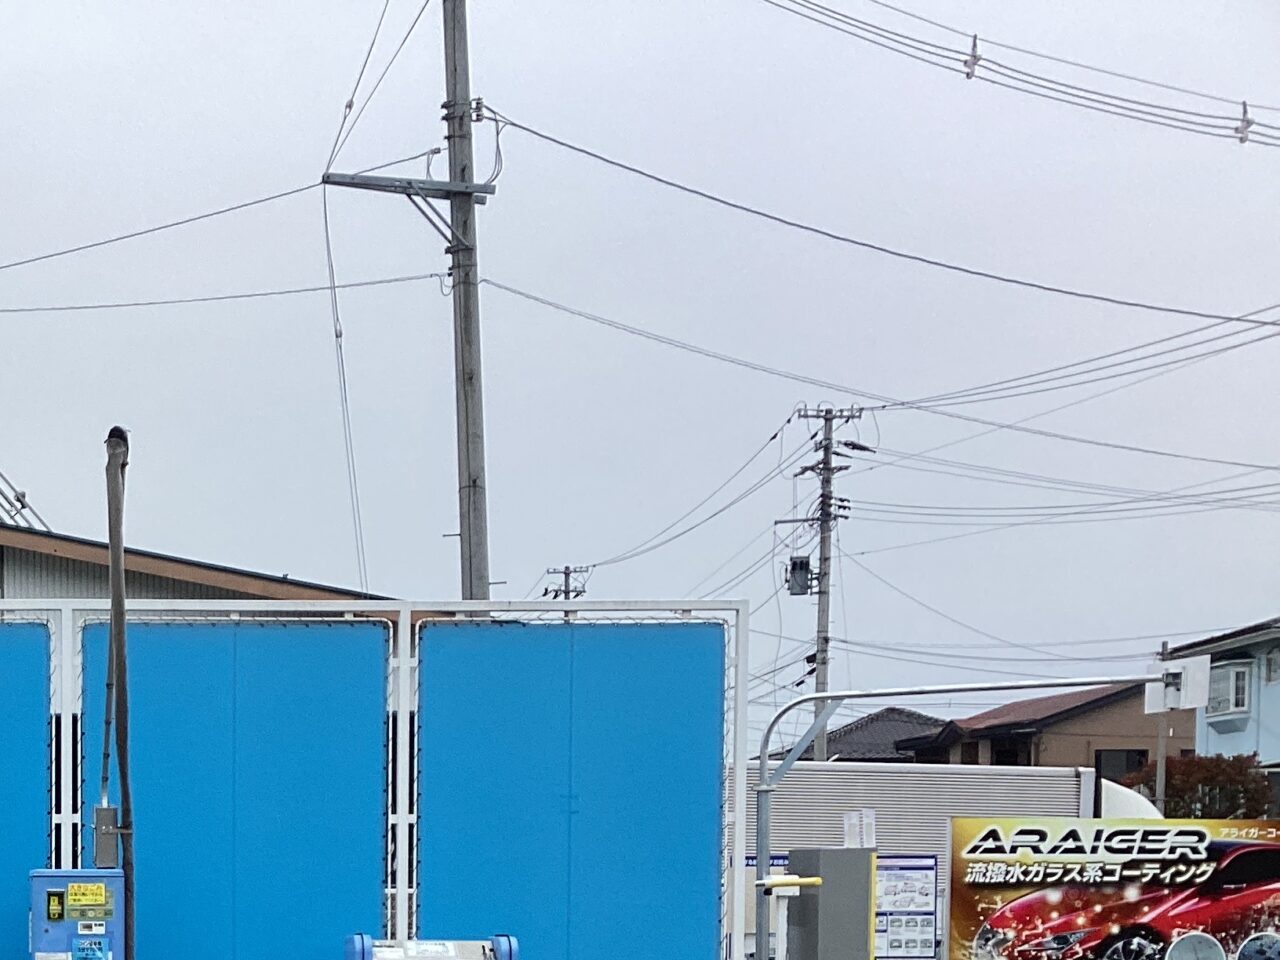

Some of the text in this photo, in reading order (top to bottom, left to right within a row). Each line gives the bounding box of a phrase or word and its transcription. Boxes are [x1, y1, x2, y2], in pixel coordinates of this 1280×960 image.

[965, 827, 1209, 856] ARAIGER
[965, 861, 1217, 883] 流撥水ガラス系コーティング
